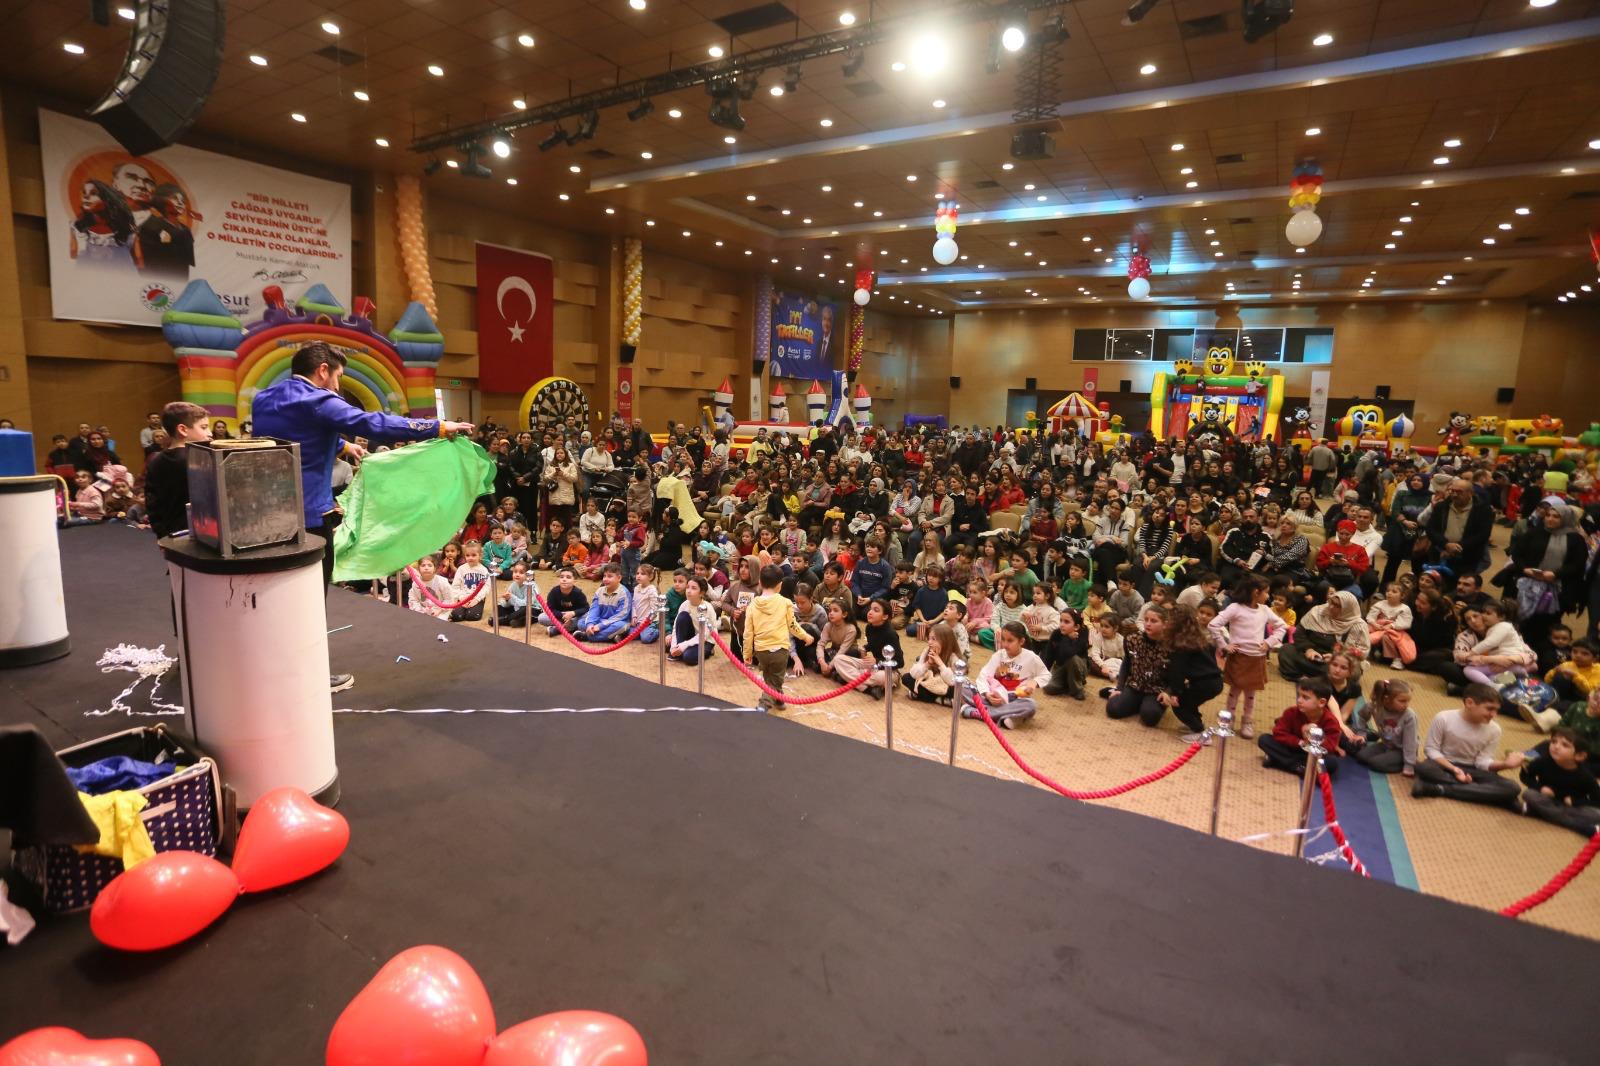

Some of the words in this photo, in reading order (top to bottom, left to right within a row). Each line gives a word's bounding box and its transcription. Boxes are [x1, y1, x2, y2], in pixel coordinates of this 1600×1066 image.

[231, 201, 273, 216] ÇAĞDAŞ
[271, 197, 309, 212] MİLLETİ
[225, 211, 290, 230] SEVİYESİNİN
[207, 231, 215, 240] O
[218, 233, 266, 248] MİLLETİN
[222, 222, 283, 240] ÇIKARACAK
[285, 234, 331, 249] OLANLAR,
